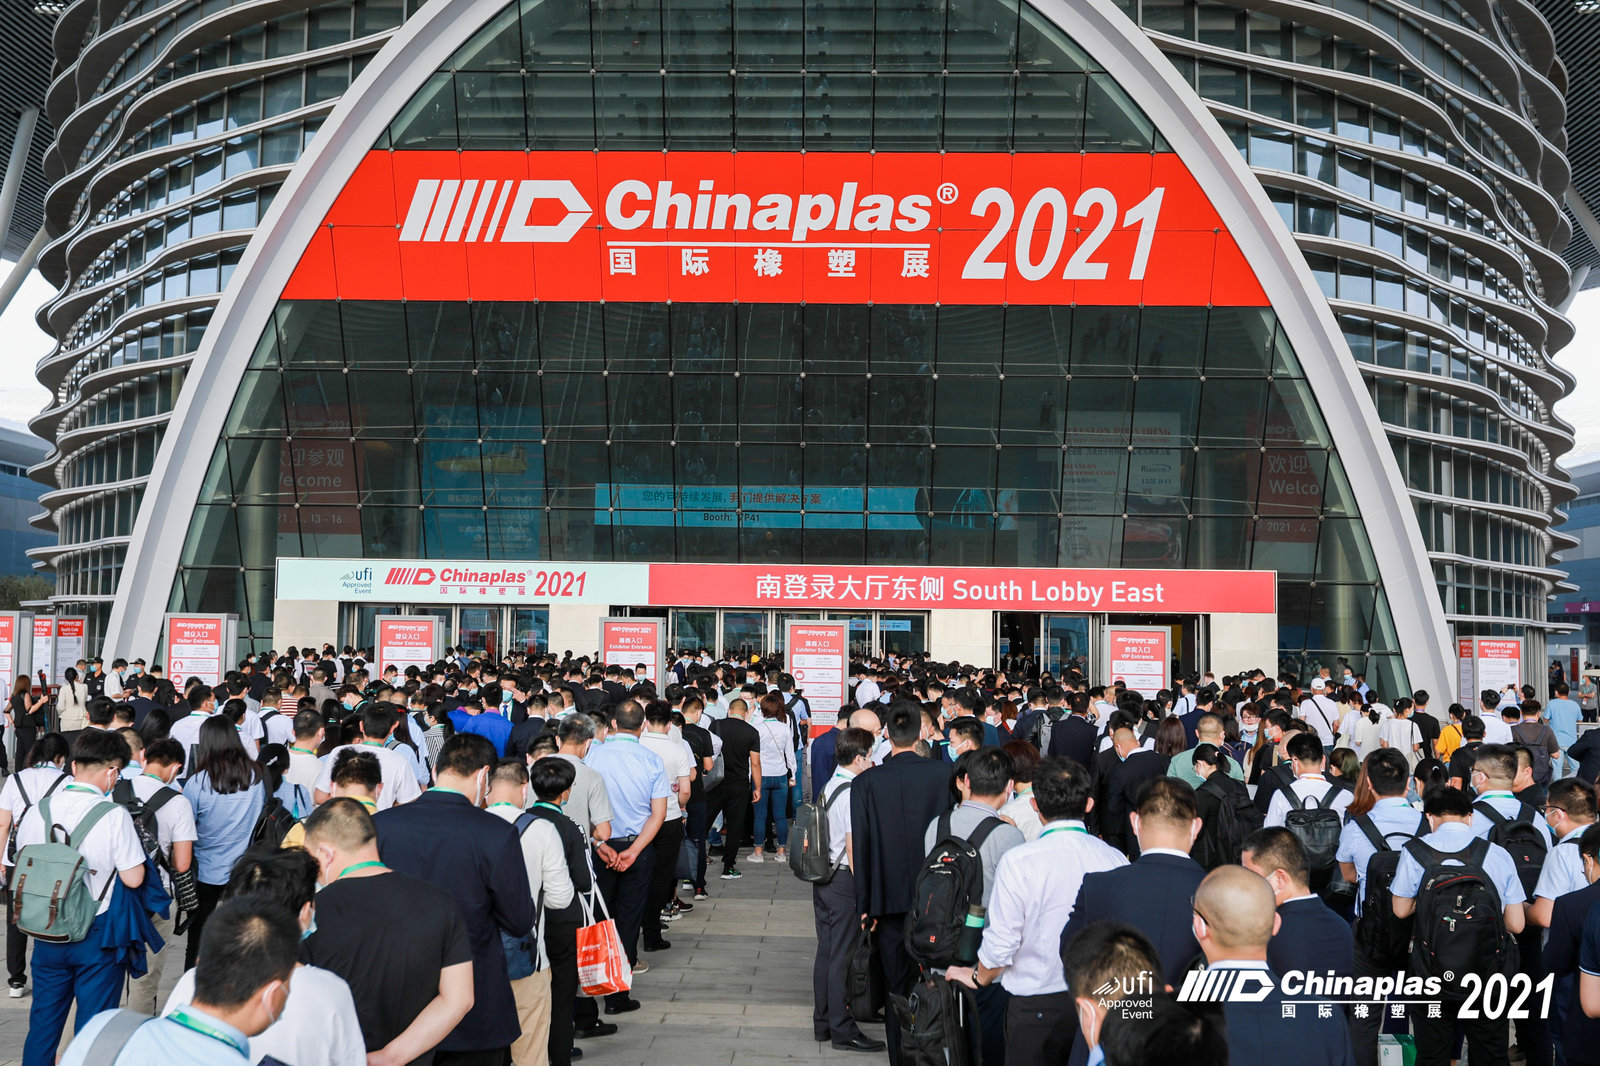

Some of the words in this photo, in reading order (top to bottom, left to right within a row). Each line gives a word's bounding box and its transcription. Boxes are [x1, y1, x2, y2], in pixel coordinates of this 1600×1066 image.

[961, 186, 1166, 281] 2021
[609, 248, 930, 278] 国际橡塑展
[703, 512, 733, 522] Booth:
[342, 581, 372, 589] Approved
[355, 567, 373, 581] ufi
[534, 570, 587, 597] 2021
[756, 574, 945, 602] 南登录大厅东侧
[952, 579, 1023, 601] South
[1031, 580, 1103, 607] Lobby
[1111, 582, 1164, 603] East
